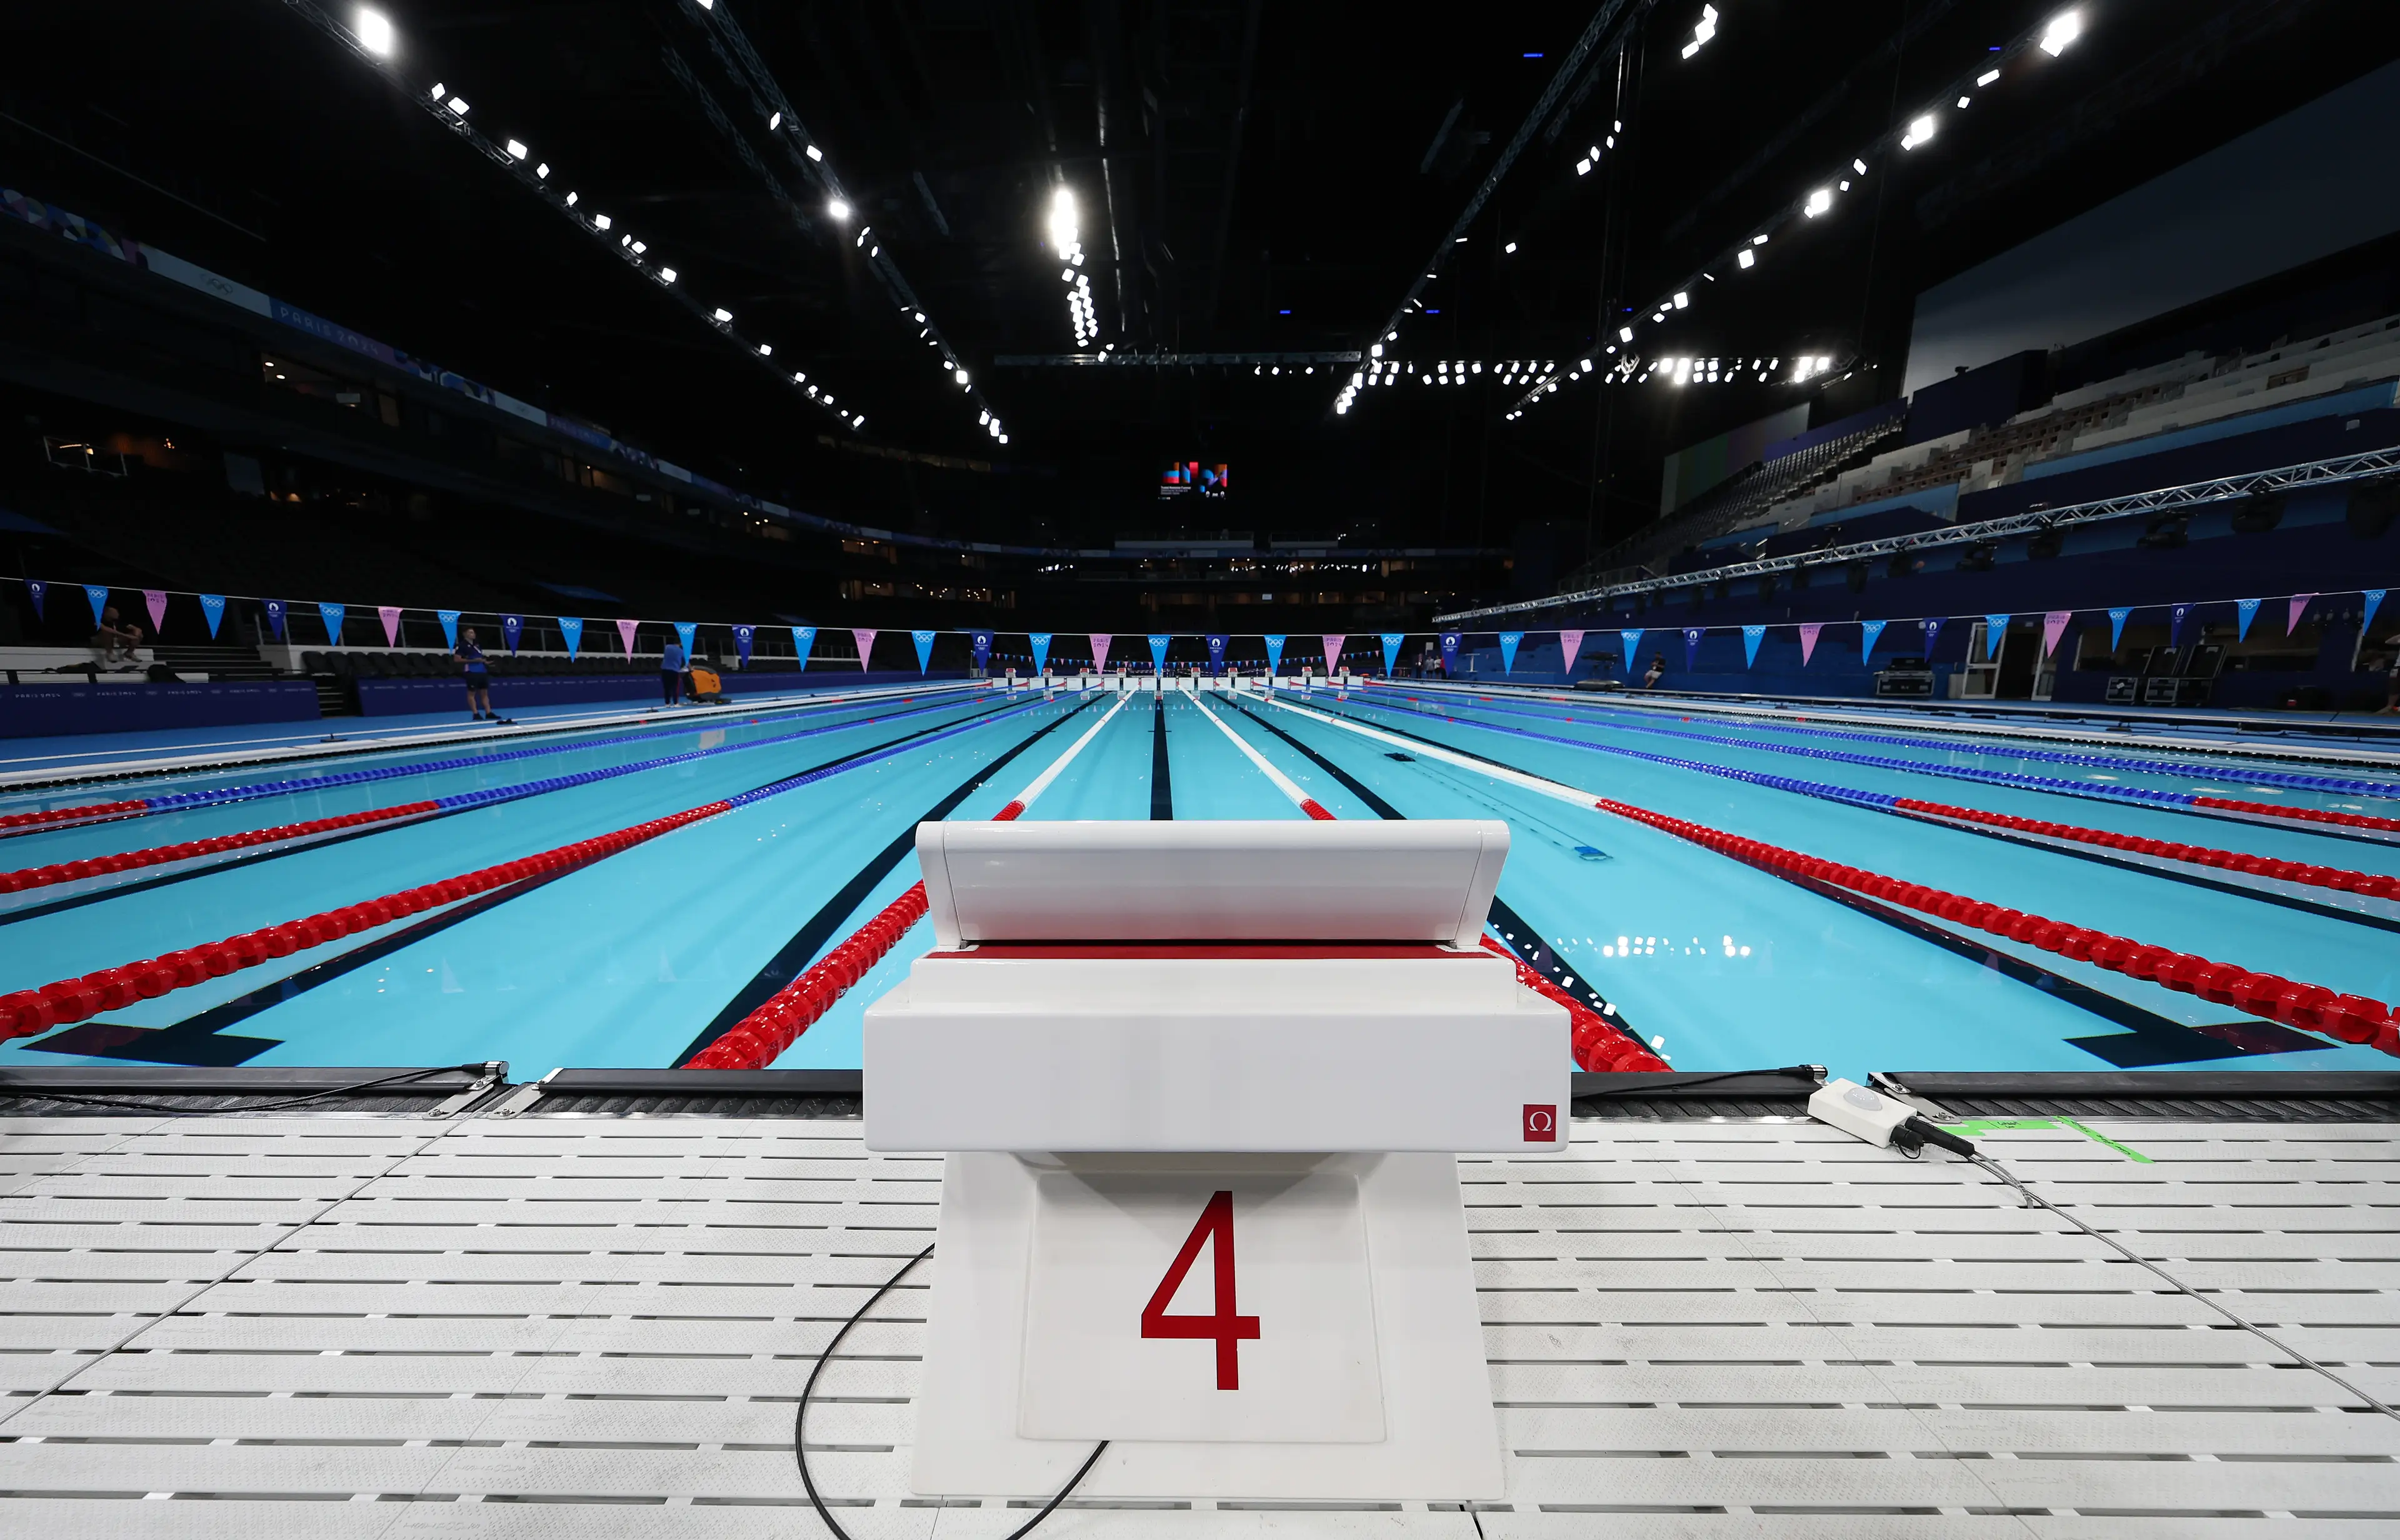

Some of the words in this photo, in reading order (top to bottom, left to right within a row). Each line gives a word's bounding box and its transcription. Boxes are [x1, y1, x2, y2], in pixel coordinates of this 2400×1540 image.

[280, 306, 332, 336] PARIS
[337, 330, 378, 355] 2024
[1141, 1190, 1261, 1391] 4
